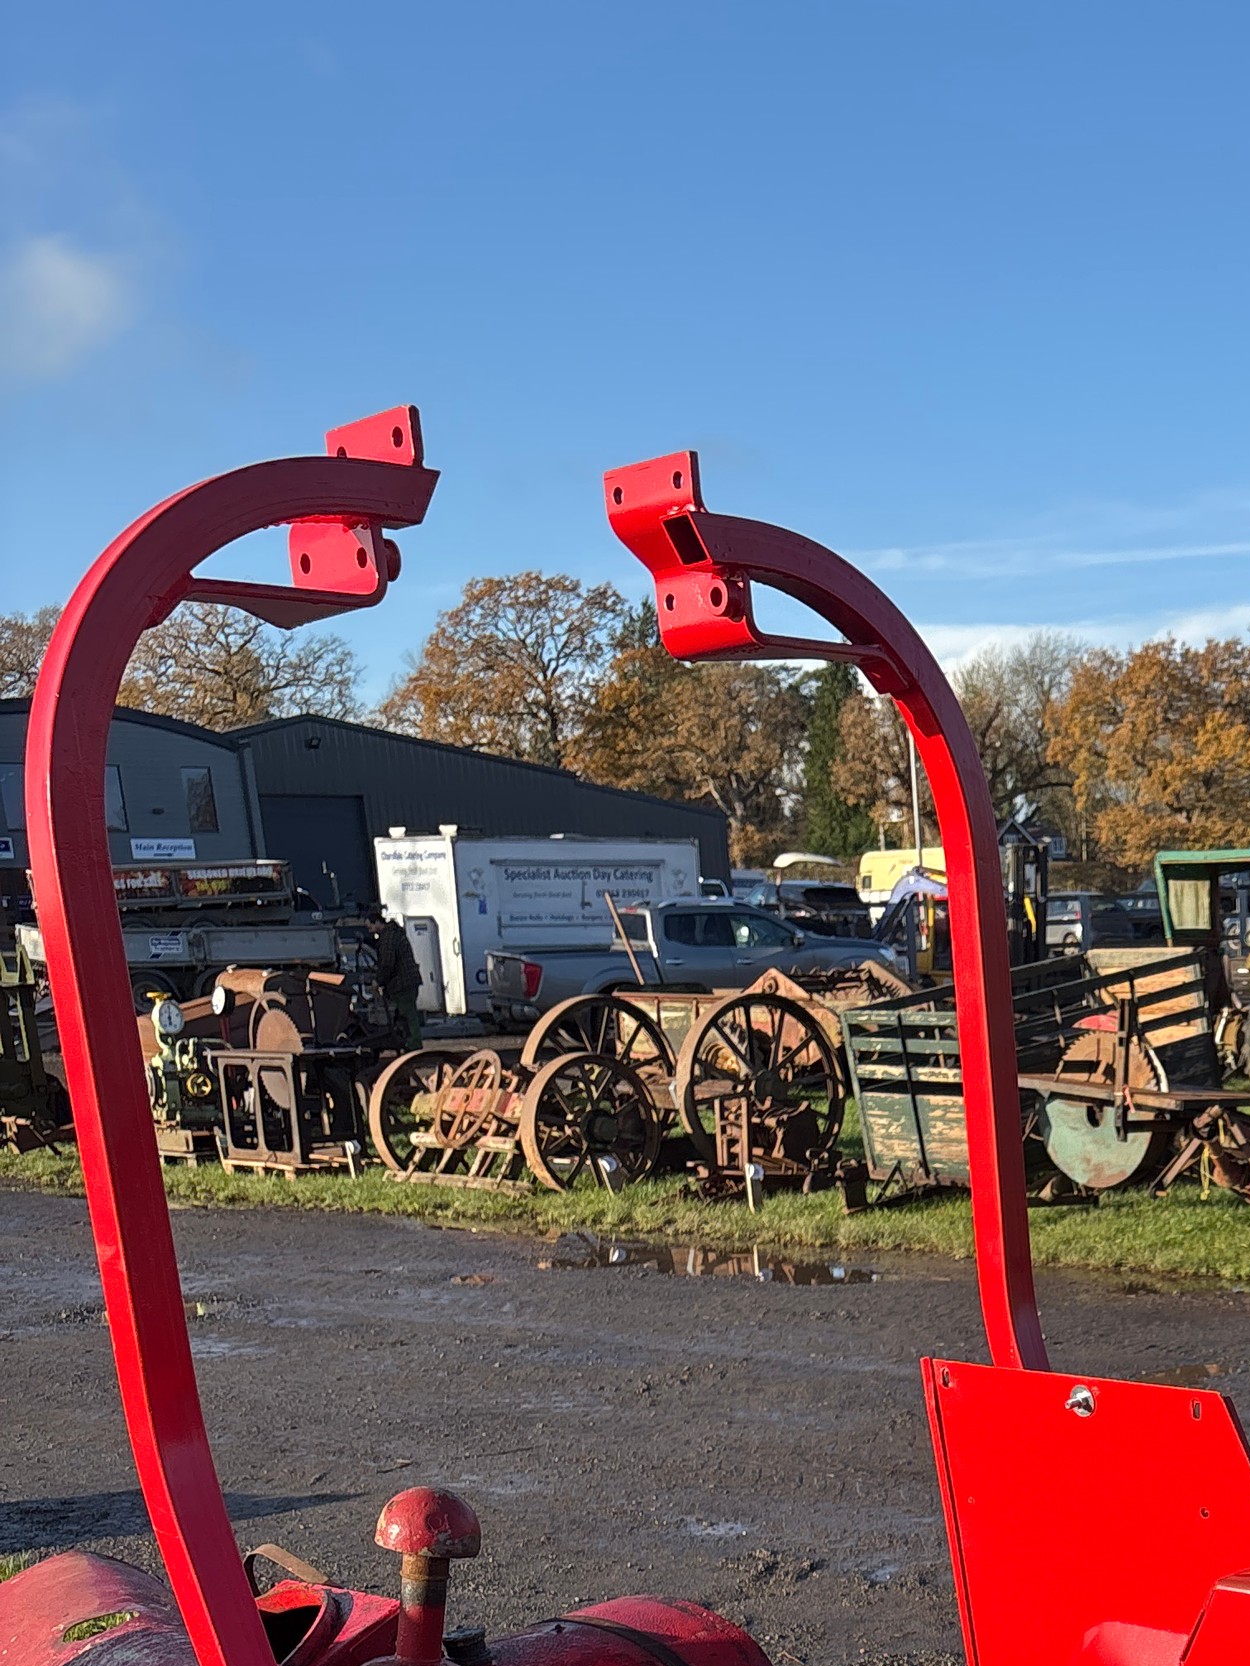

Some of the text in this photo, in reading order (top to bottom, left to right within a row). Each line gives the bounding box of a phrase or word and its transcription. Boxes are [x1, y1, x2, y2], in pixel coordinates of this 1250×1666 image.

[135, 843, 192, 852] Main Reception
[504, 868, 653, 882] Specialist Auction Day Catering
